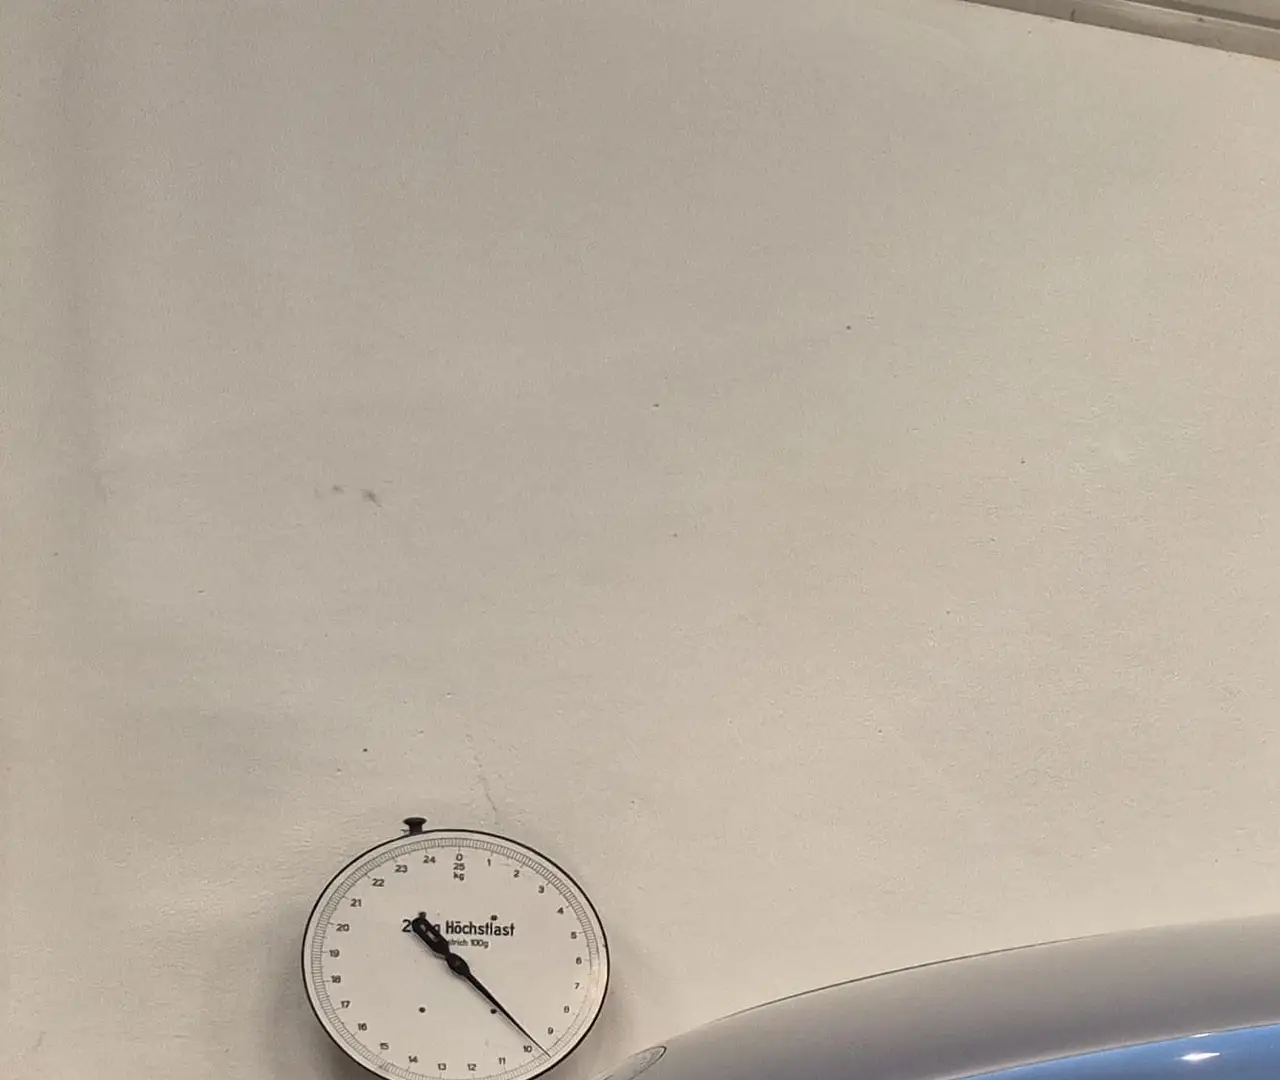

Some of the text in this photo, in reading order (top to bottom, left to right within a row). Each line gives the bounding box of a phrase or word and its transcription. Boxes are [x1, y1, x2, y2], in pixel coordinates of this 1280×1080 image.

[423, 855, 436, 864] 24
[456, 853, 464, 863] 0
[486, 858, 491, 867] 1
[395, 864, 408, 873] 23
[453, 862, 465, 871] 25
[453, 871, 465, 881] kg
[513, 869, 520, 878] 2
[372, 878, 385, 887] 22
[538, 885, 545, 894] 3
[350, 898, 362, 908] 21
[557, 907, 564, 915] 4
[336, 923, 350, 932] 20
[446, 920, 515, 937] Höchstlast
[571, 931, 577, 940] 5
[329, 949, 340, 958] 19
[576, 957, 582, 965] 6
[331, 975, 341, 984] 18
[574, 982, 579, 991] 7
[341, 1000, 350, 1009] 17
[564, 1005, 570, 1014] 8
[357, 1022, 367, 1031] 16
[548, 1027, 554, 1035] 9
[380, 1042, 389, 1051] 15
[523, 1045, 533, 1053] 10
[408, 1055, 418, 1063] 14
[498, 1057, 506, 1065] 11
[437, 1062, 447, 1071] 13
[467, 1062, 476, 1071] 12
